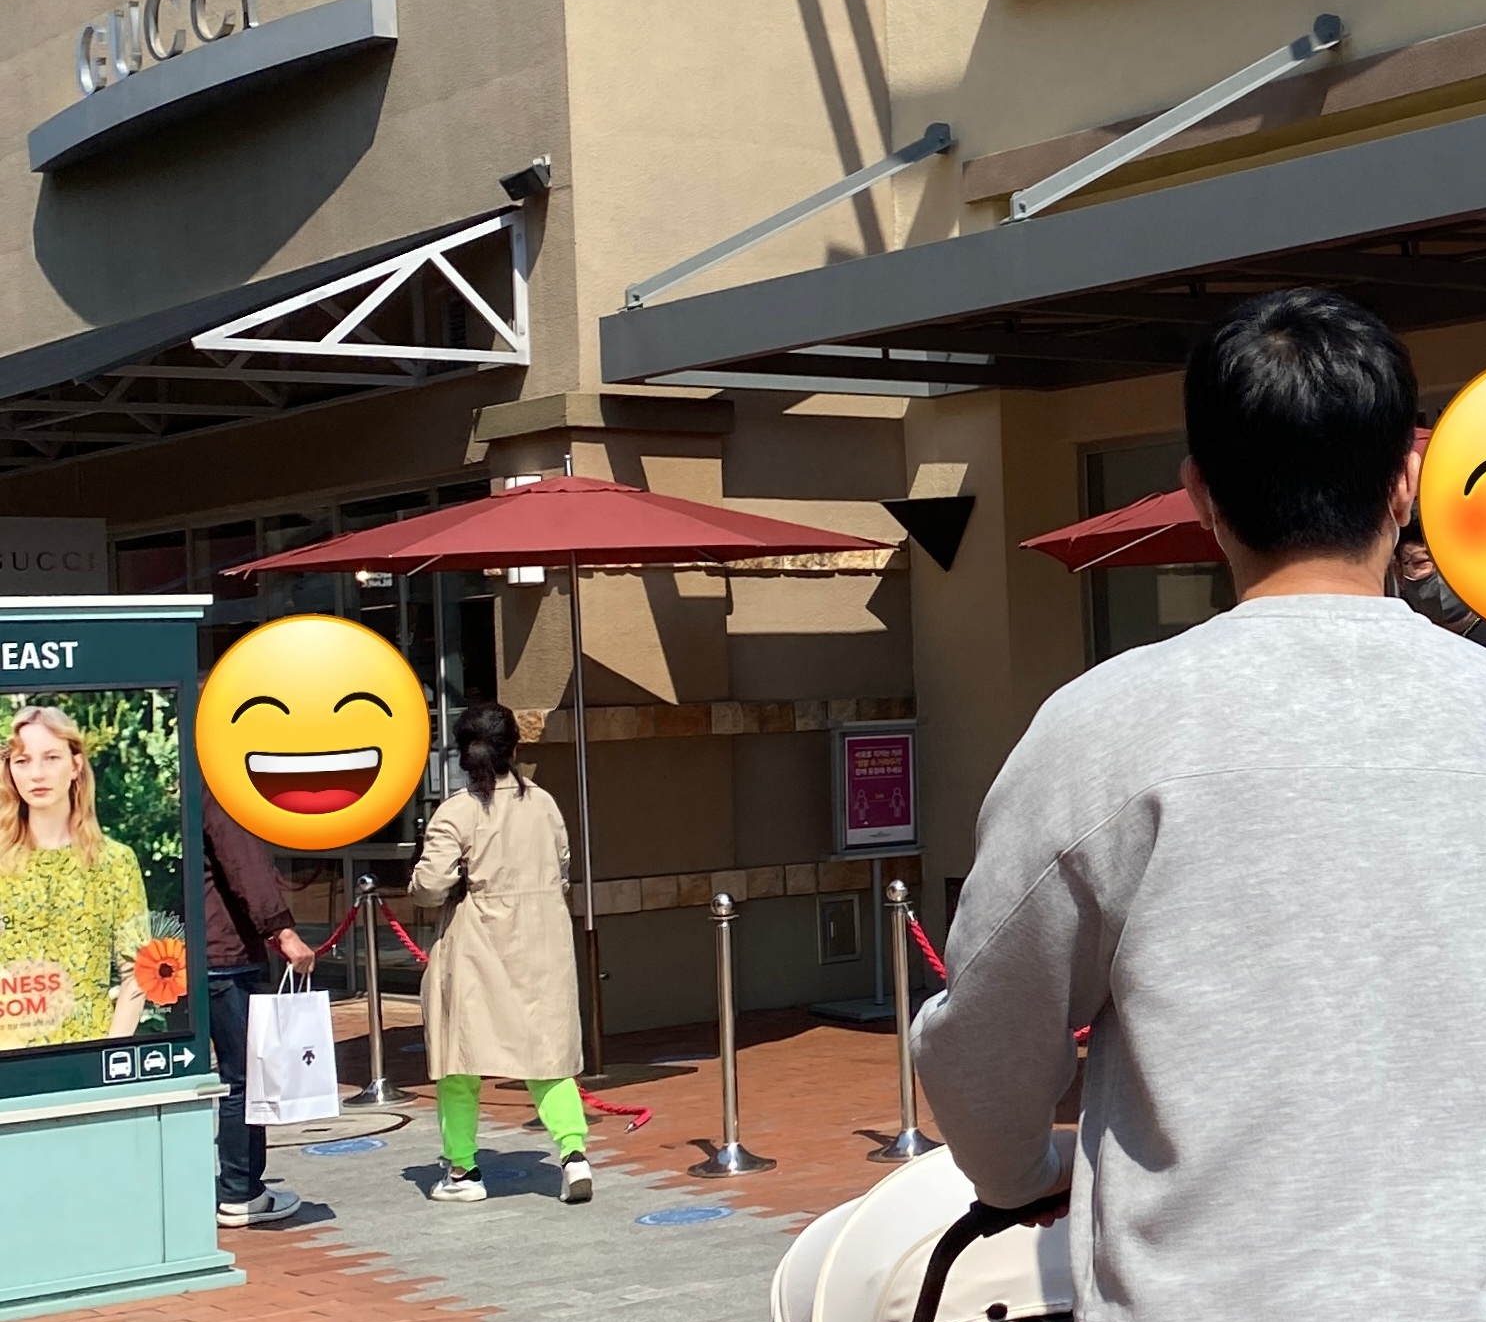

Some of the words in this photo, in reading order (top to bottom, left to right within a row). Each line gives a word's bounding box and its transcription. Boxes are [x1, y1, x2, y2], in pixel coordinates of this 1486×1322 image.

[0, 551, 96, 572] UCCI
[2, 640, 78, 670] EAST
[0, 913, 15, 930] 인
